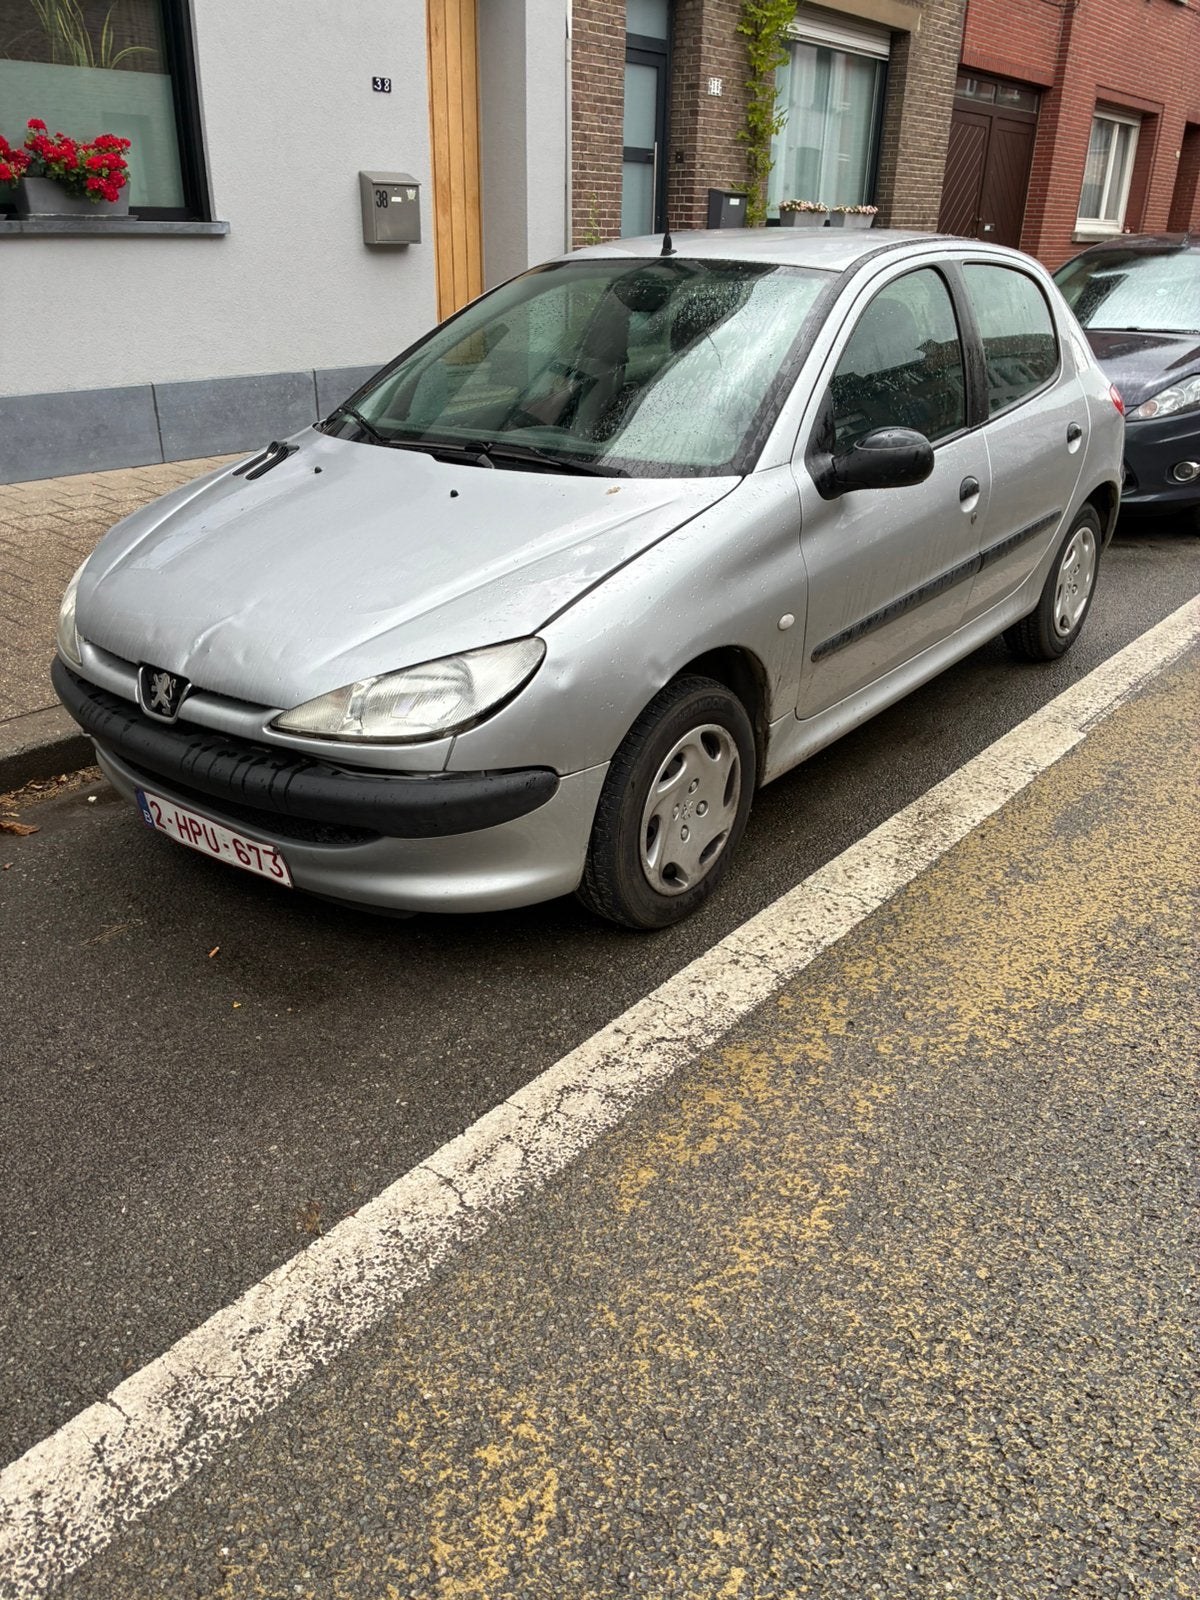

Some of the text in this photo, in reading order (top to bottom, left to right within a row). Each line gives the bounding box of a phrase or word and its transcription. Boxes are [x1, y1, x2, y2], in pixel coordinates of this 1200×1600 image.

[374, 78, 390, 91] 38
[376, 190, 388, 208] 38
[143, 810, 152, 823] B
[150, 801, 284, 878] 2-HPU-673
